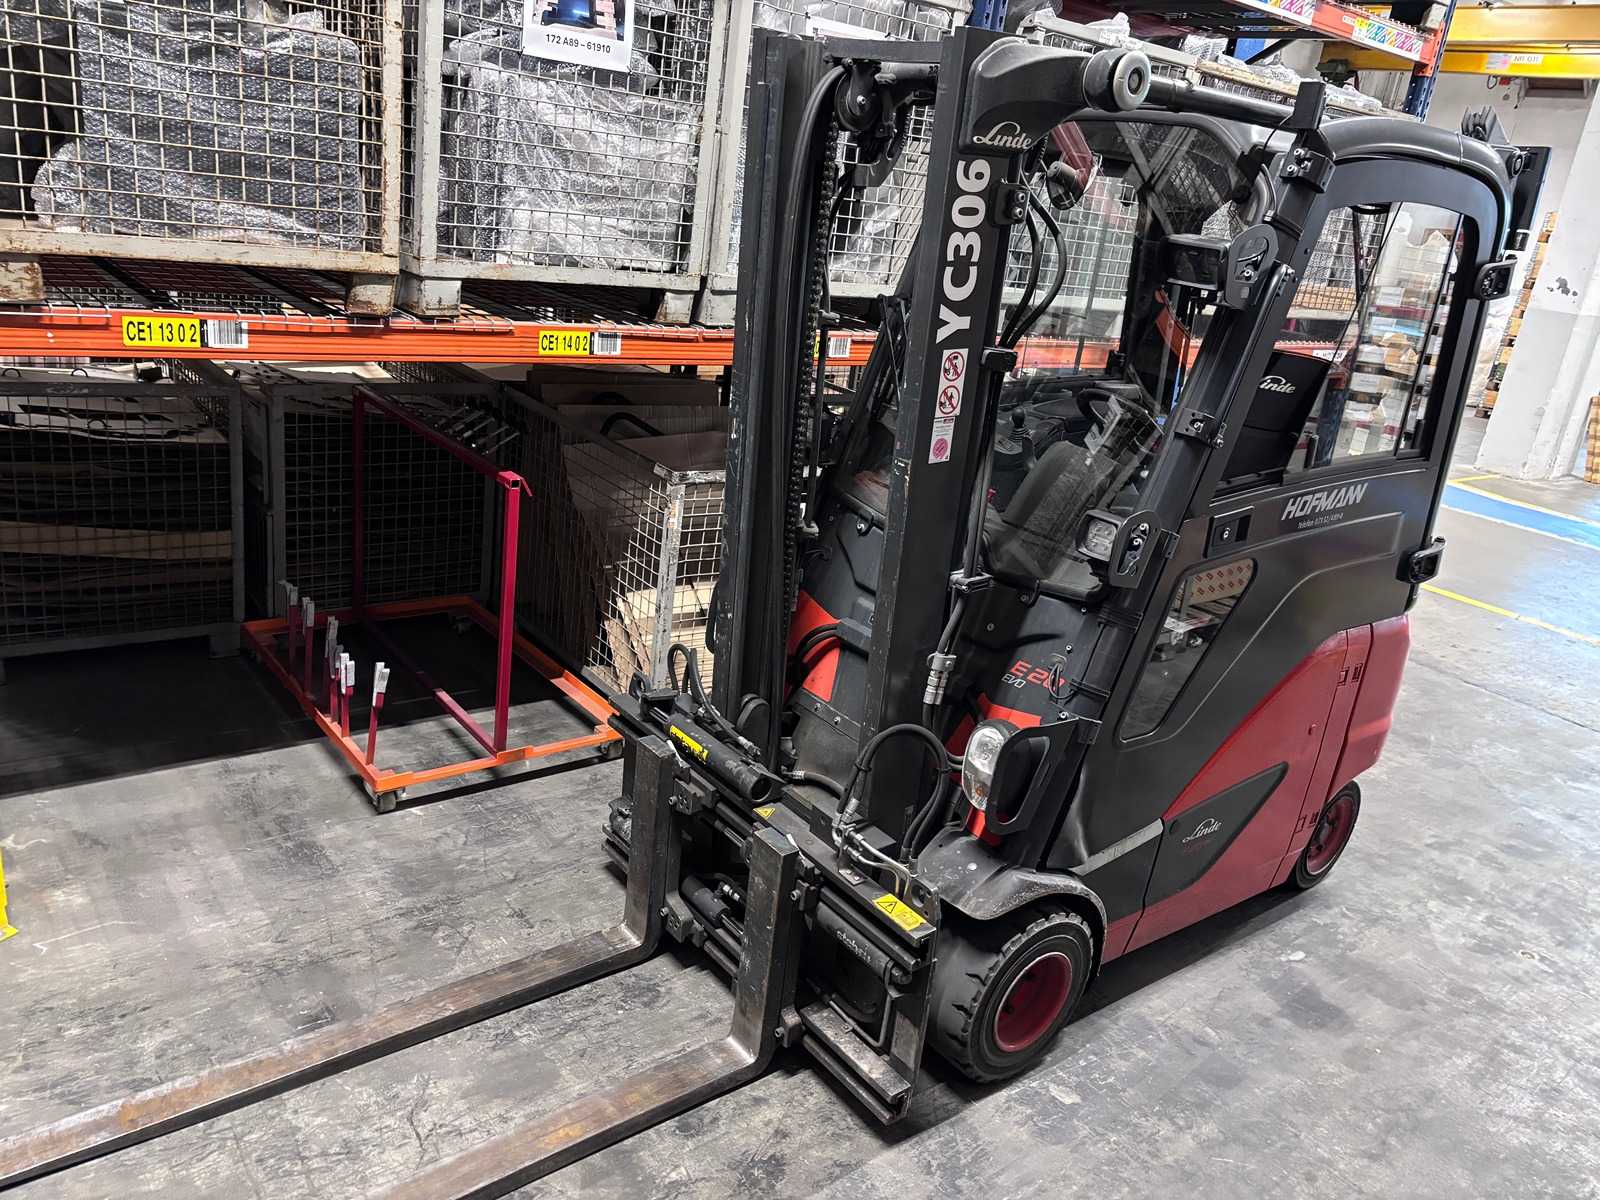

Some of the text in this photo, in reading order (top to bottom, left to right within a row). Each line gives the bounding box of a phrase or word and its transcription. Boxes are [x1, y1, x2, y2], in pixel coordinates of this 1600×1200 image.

[545, 34, 561, 44] 172
[563, 37, 579, 47] A89
[586, 42, 611, 53] 61910
[973, 121, 1032, 149] Linde
[936, 159, 990, 344] YC306
[126, 321, 198, 342] CE1 13 0 2
[541, 334, 588, 351] CE1 14 0 2
[1281, 482, 1368, 520] HOFMANN
[1001, 673, 1026, 688] EVO
[1182, 818, 1222, 843] Linde
